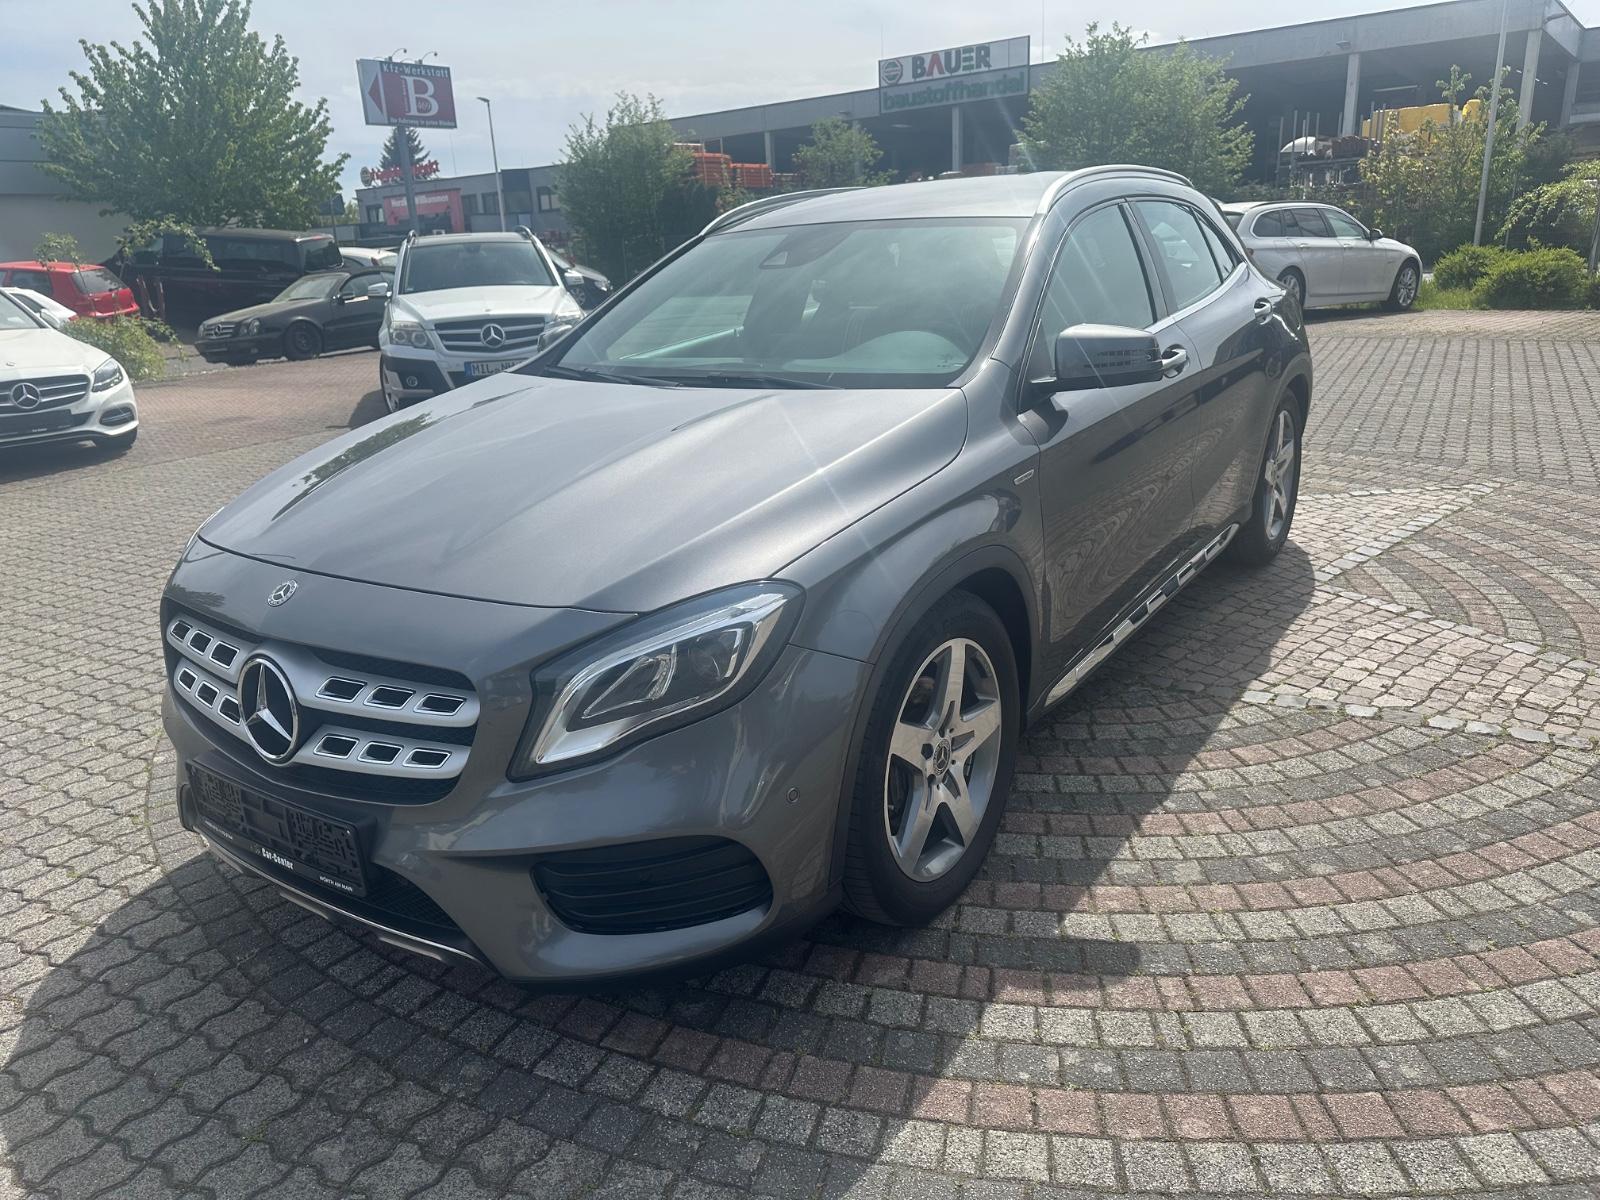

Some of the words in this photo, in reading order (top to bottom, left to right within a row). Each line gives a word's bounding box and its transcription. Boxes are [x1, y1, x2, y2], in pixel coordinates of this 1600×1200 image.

[383, 63, 449, 78] Kfz-Werkstatt
[911, 44, 992, 79] BAUER
[400, 75, 440, 117] B
[882, 71, 1025, 110] baustoffhandel
[261, 847, 294, 870] Car-Center
